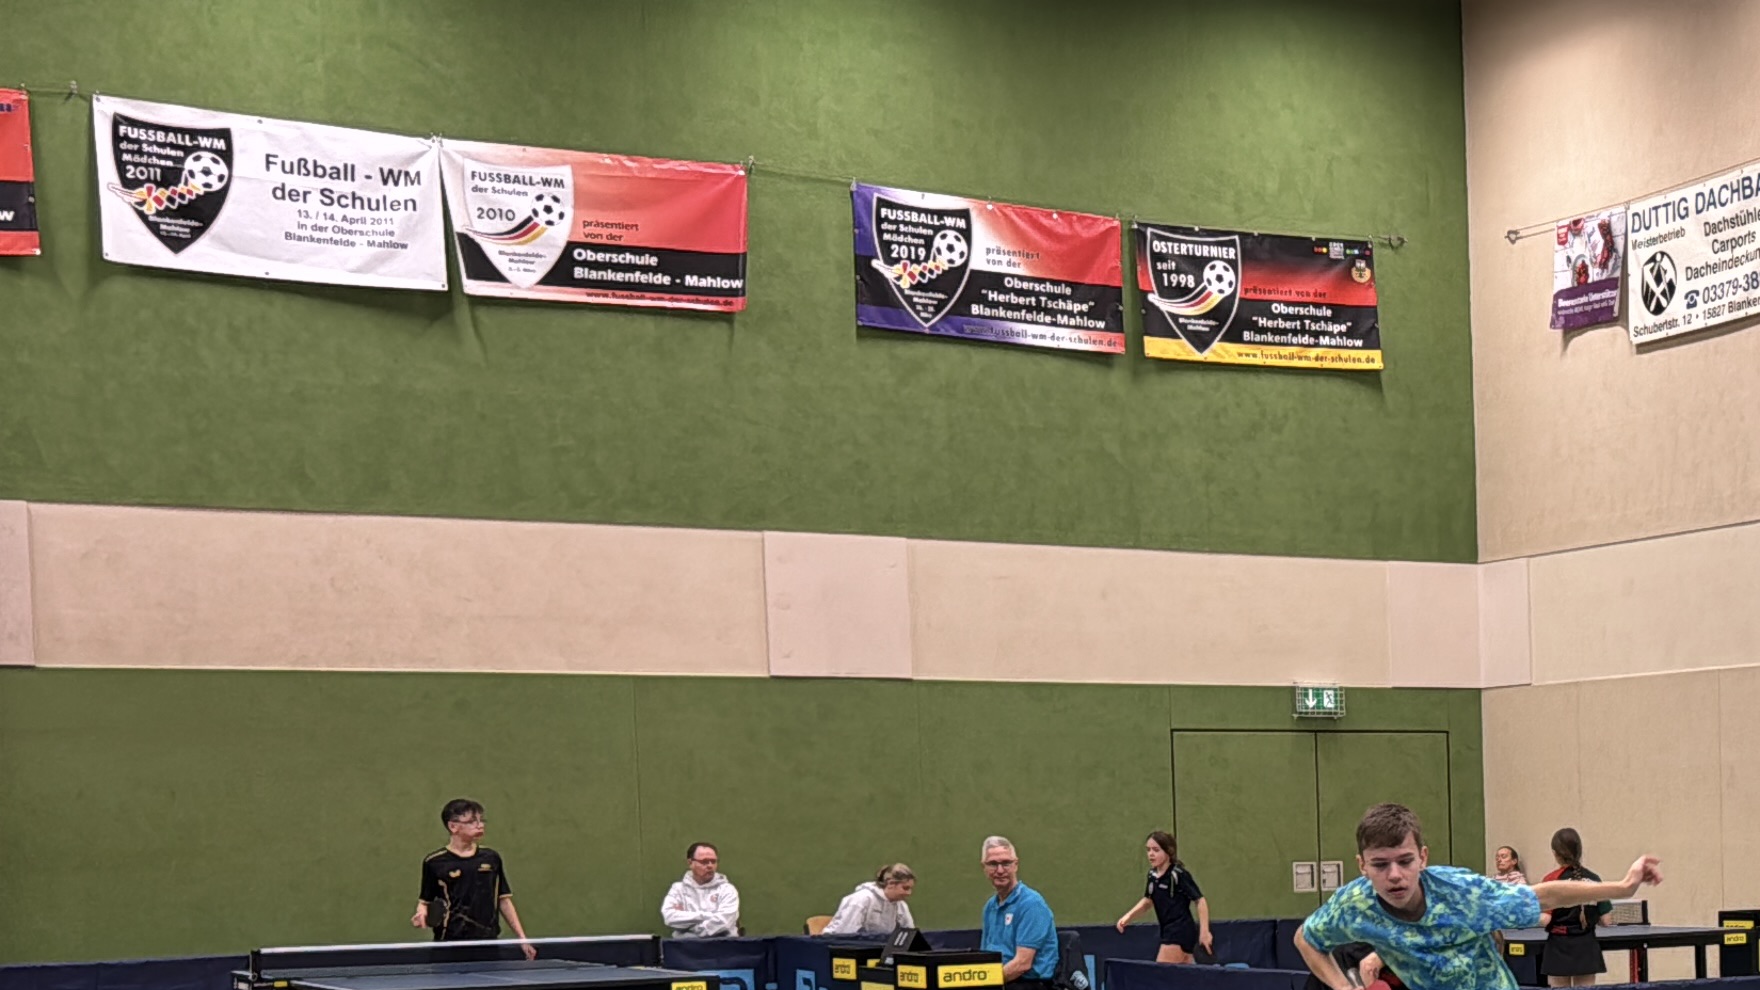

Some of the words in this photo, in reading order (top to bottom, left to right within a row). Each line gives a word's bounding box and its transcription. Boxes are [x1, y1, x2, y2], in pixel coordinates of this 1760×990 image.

[119, 125, 227, 150] FUSSBALL-WM
[119, 141, 140, 150] der
[141, 143, 185, 158] Schulen
[125, 165, 162, 181] 2011
[265, 153, 355, 182] Fußball
[379, 167, 422, 187] WM
[471, 171, 565, 188] FUSSBALL-WM
[271, 182, 312, 204] der
[319, 187, 418, 212] Schulen
[471, 185, 488, 193] der
[492, 186, 528, 196] Schulen
[297, 209, 313, 219] 13.
[323, 212, 338, 222] 14.
[341, 214, 367, 226] April
[370, 217, 394, 226] 2011
[477, 207, 516, 221] 2010
[880, 208, 967, 229] FUSSBALL-WM
[1631, 197, 1689, 234] DUTTIG
[311, 223, 329, 233] der
[332, 226, 395, 237] Oberschule
[583, 220, 639, 231] präsentiert
[881, 222, 897, 230] der
[899, 224, 934, 235] Schulen
[284, 231, 357, 248] Blankenfelde
[367, 240, 409, 249] Mahlow
[583, 232, 603, 240] von
[606, 232, 624, 241] der
[1711, 230, 1756, 254] Carports
[573, 248, 658, 266] Oberschule
[891, 245, 926, 260] 2019
[986, 246, 1040, 260] präsentiert
[1152, 240, 1236, 260] OSTERTURNIER
[986, 258, 1003, 266] von
[1006, 259, 1022, 268] der
[1156, 260, 1176, 270] seit
[574, 267, 671, 286] Blankenfelde
[685, 275, 743, 289] Mahlow
[1004, 277, 1072, 295] Oberschule
[1162, 273, 1195, 288] 1998
[1244, 286, 1292, 297] präsentiert
[1313, 290, 1327, 298] der
[971, 304, 1106, 329] Blankenfelde-Mahlow
[1271, 303, 1333, 317] Oberschule
[1633, 316, 1680, 338] Schubertstr.
[1682, 313, 1693, 325] 12
[1702, 304, 1726, 321] 15827
[1243, 331, 1363, 347] Blankenfelde-Mahlow
[943, 968, 988, 983] andro
